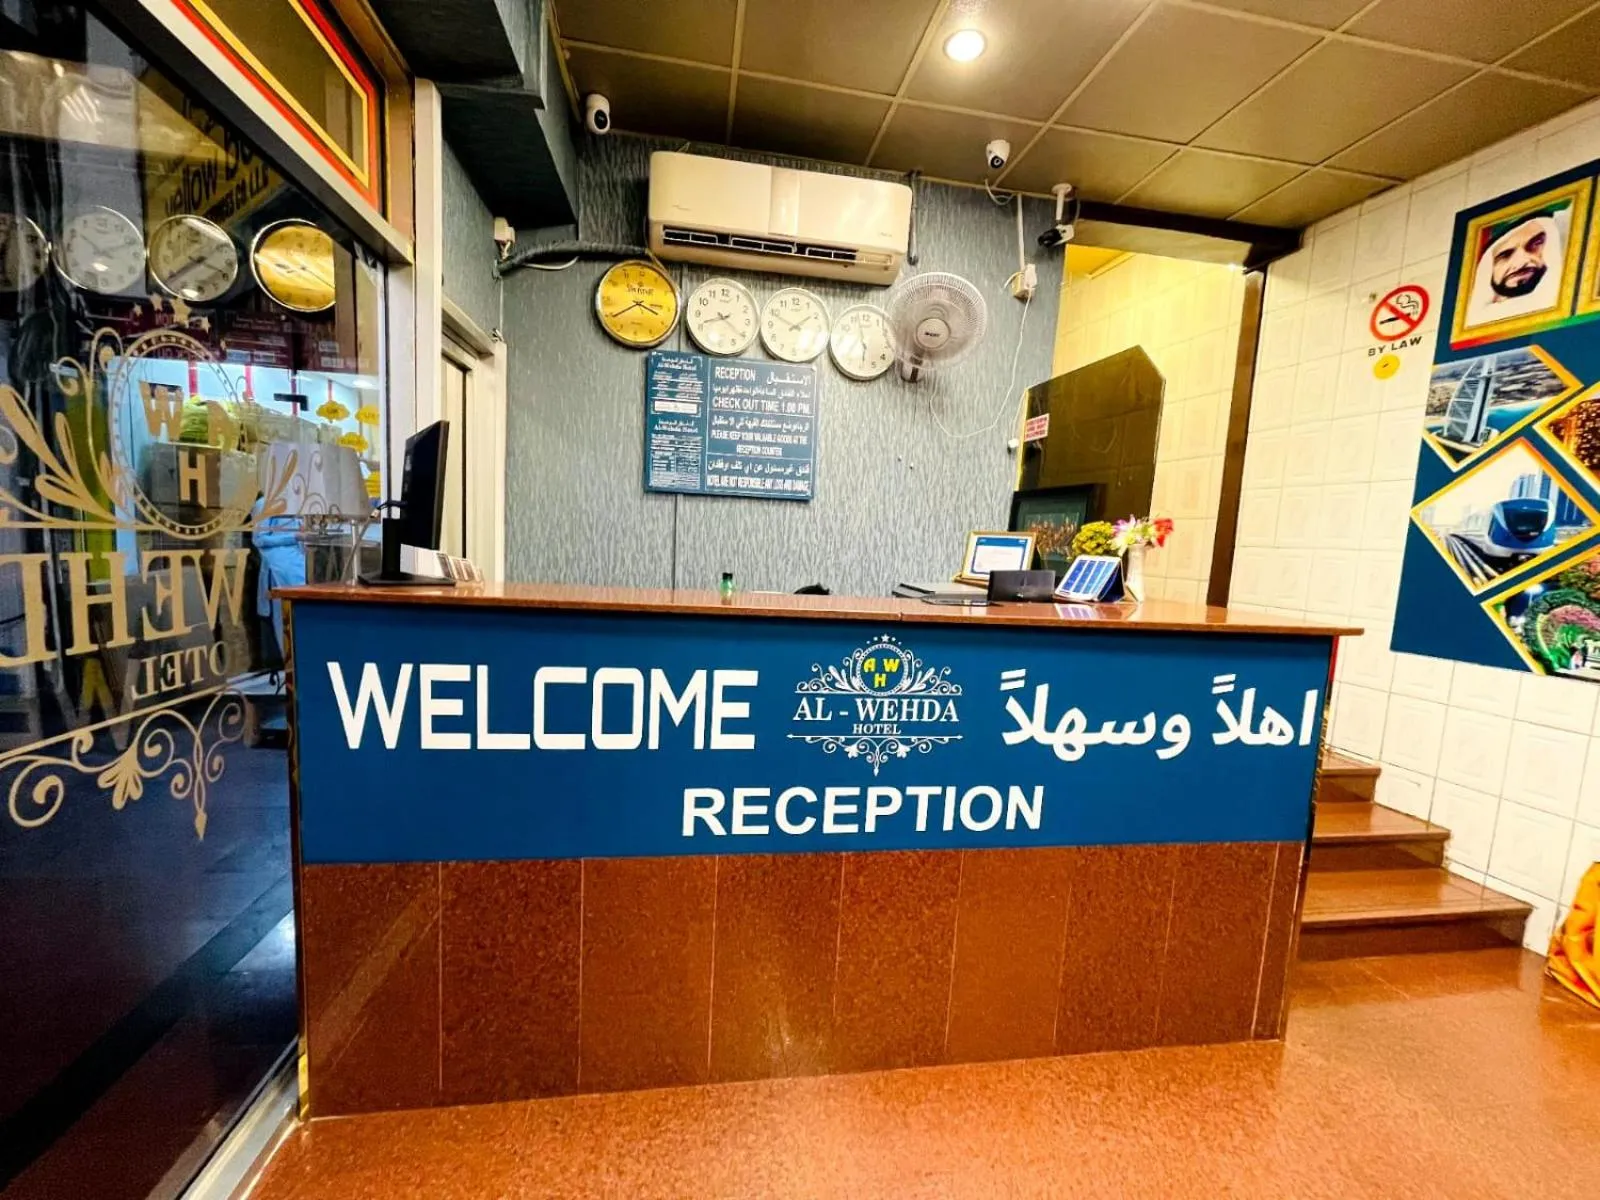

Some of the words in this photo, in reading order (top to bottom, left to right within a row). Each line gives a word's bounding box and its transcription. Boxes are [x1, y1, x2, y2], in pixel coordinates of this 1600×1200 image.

[1368, 345, 1386, 357] BY
[1391, 336, 1422, 350] LAW
[714, 366, 756, 381] RECEPTION
[712, 396, 740, 409] CHECK
[742, 399, 760, 411] OUT
[760, 400, 780, 412] TIME
[863, 658, 876, 672] A
[883, 658, 900, 672] W
[874, 673, 887, 688] H
[326, 661, 759, 750] WELCOME
[793, 697, 832, 721] AL
[855, 698, 959, 722] WEHDA
[852, 724, 902, 735] HOTEL
[682, 785, 1044, 837] RECEPTION
